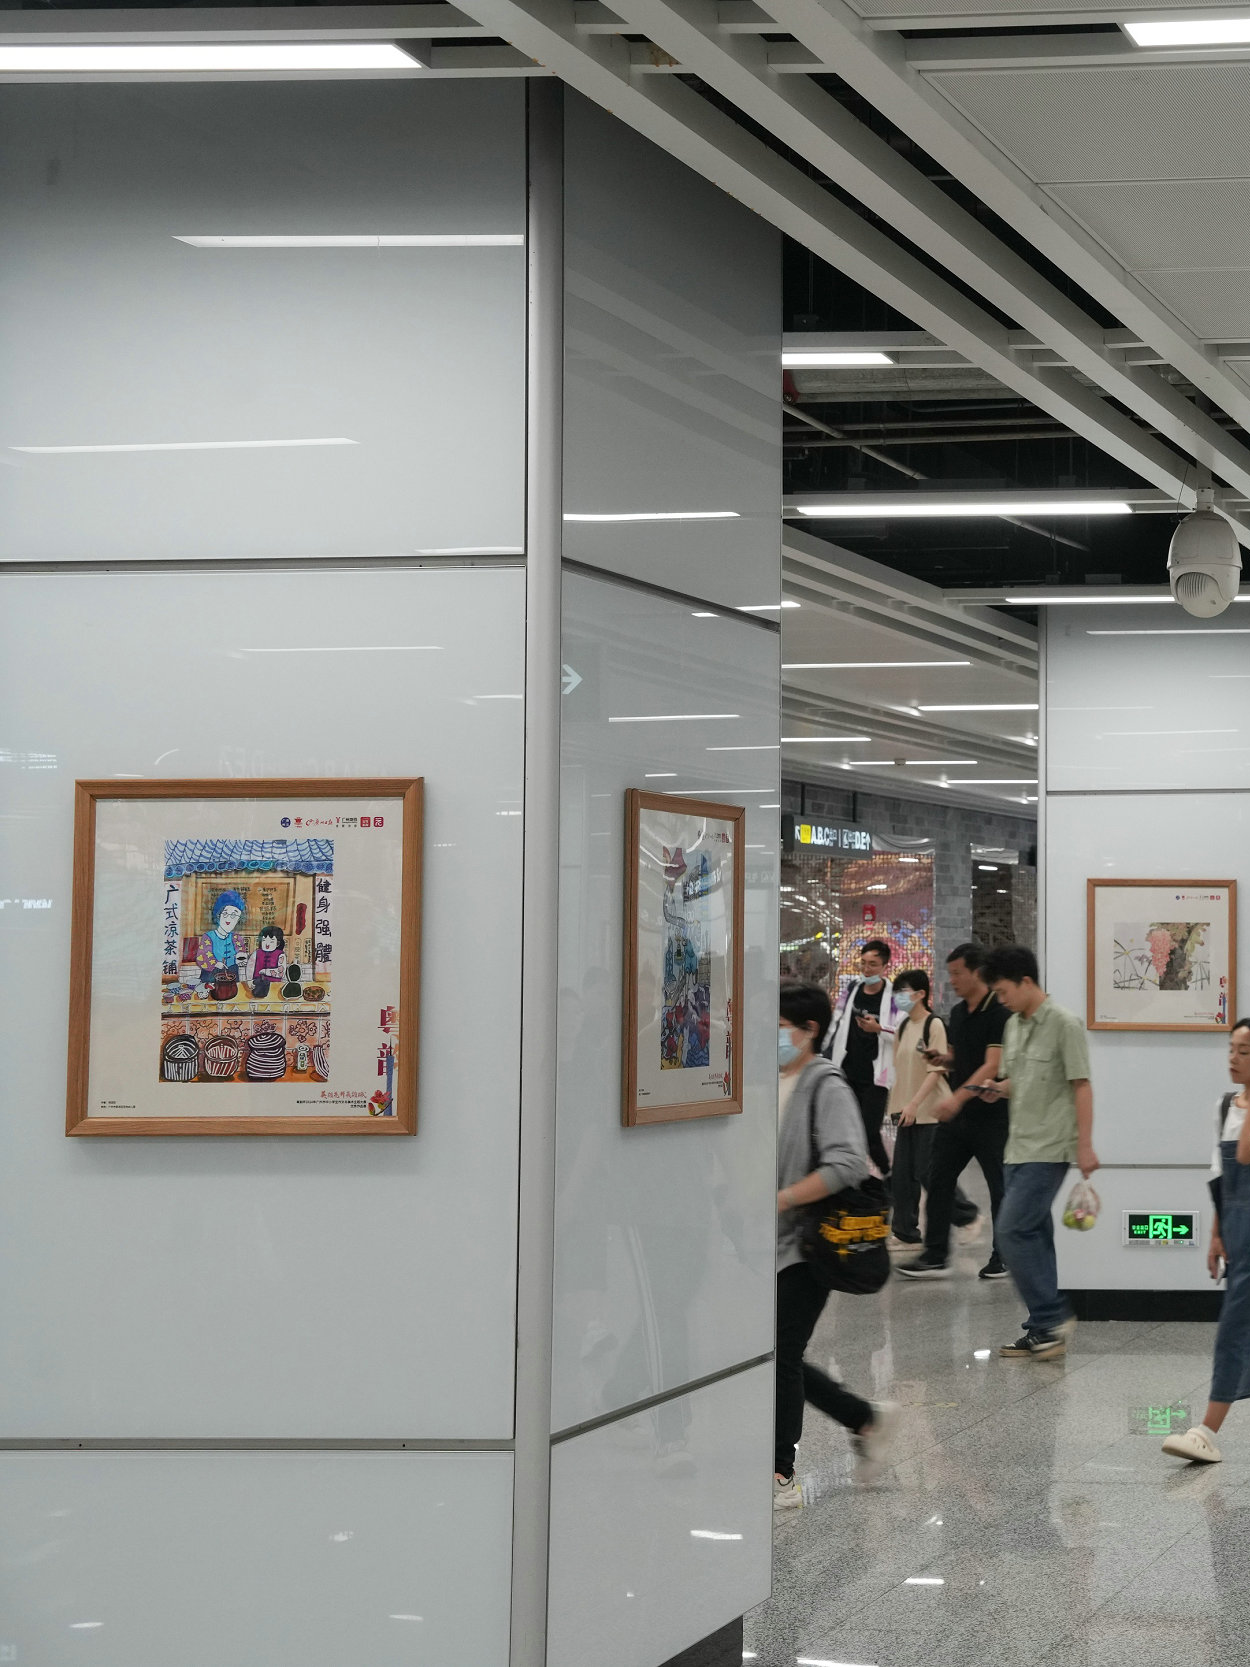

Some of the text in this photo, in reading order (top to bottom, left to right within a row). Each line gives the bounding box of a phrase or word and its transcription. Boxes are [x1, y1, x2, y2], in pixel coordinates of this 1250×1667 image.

[162, 884, 179, 975] 广式凉茶铺
